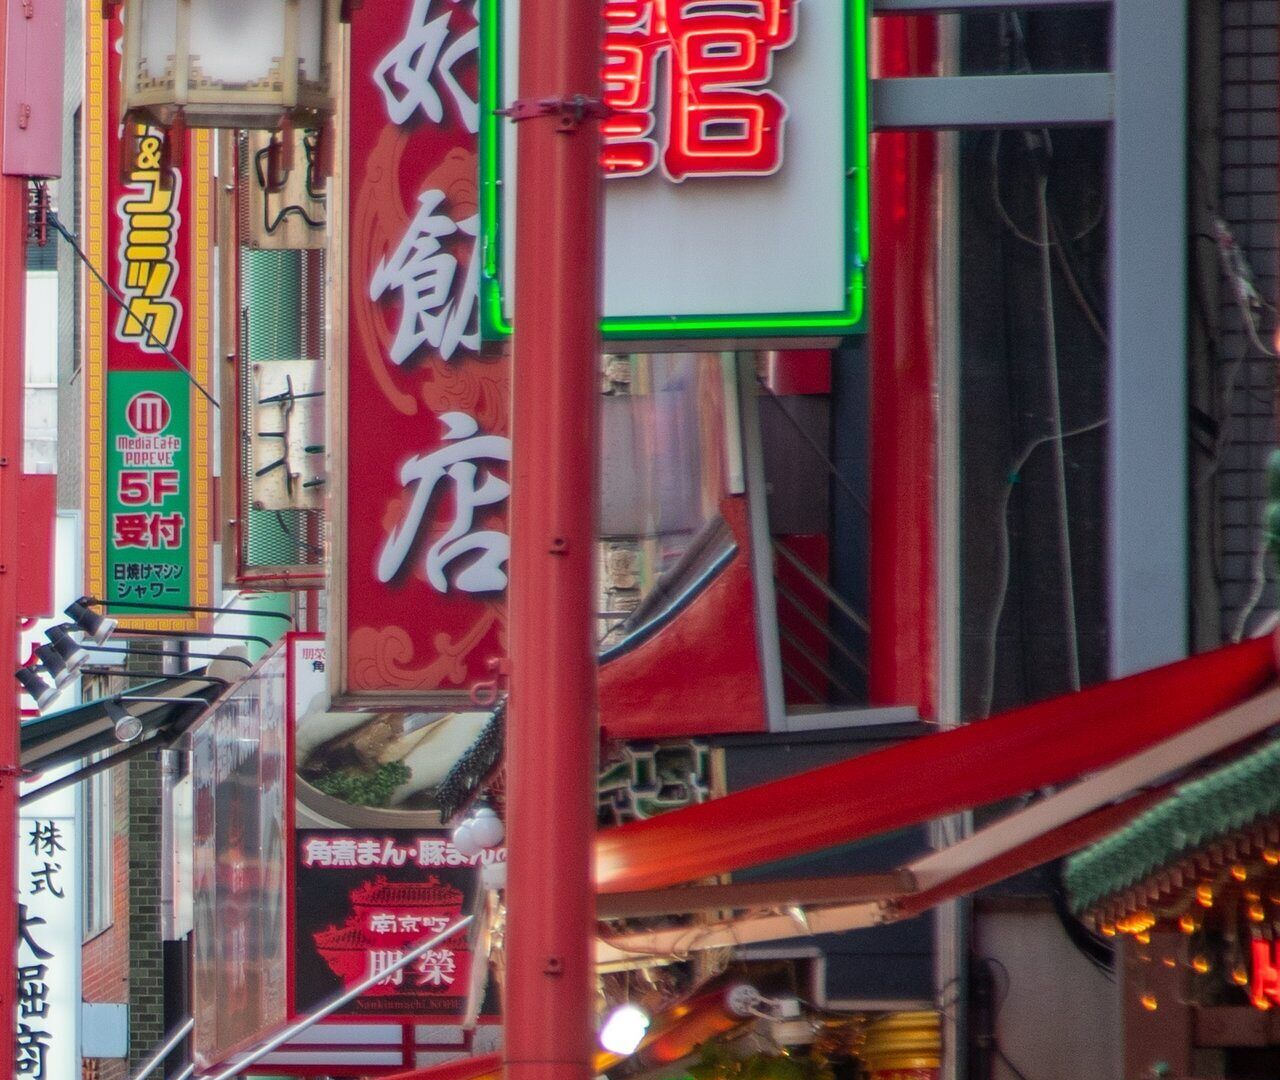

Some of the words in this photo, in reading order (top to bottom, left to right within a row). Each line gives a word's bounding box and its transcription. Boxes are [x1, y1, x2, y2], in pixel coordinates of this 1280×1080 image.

[118, 436, 152, 450] Media
[154, 436, 180, 450] Cafe
[125, 451, 173, 465] POPEYE
[118, 470, 180, 506] 5F
[113, 512, 184, 549] 受付
[113, 562, 184, 581] 日焼けマシン
[117, 583, 181, 599] シャワー
